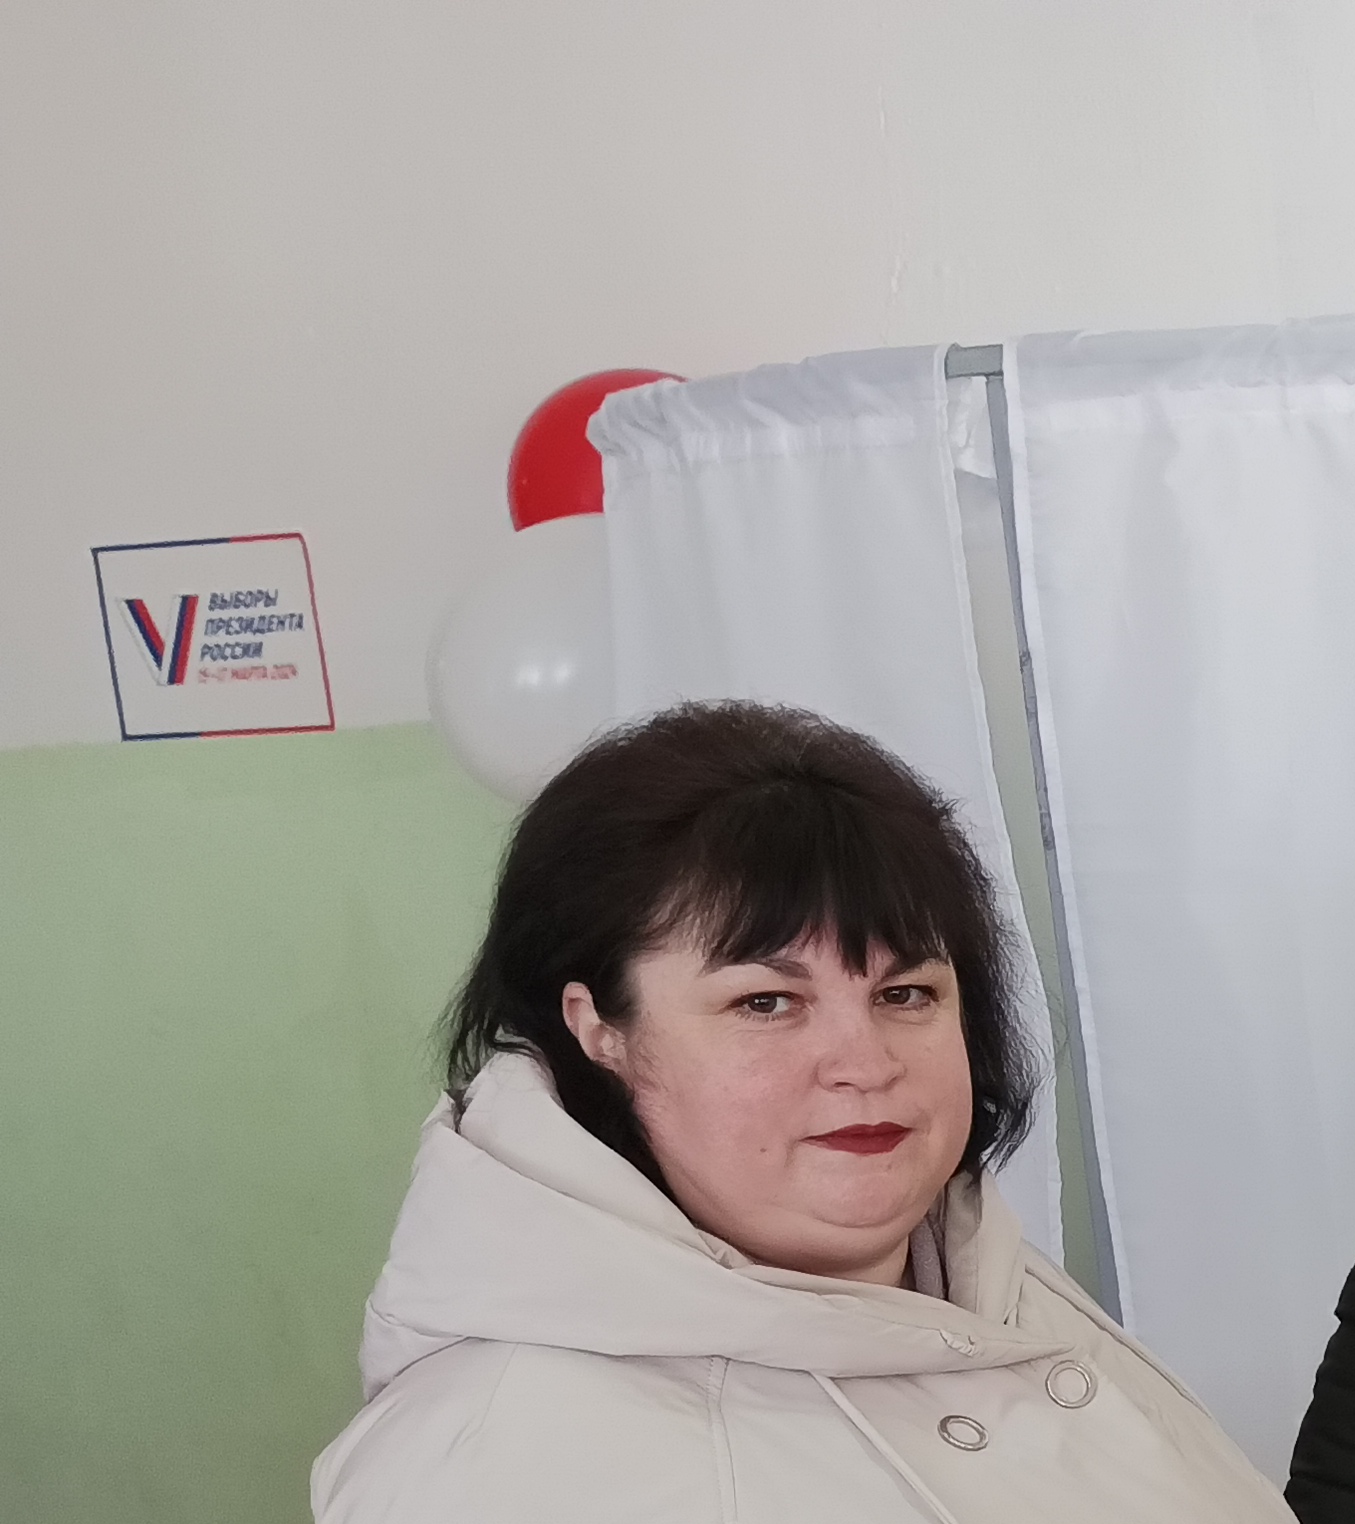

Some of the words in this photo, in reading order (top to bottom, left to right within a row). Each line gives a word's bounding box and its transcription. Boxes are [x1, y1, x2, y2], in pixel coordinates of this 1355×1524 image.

[208, 589, 278, 612] ВЫБОРЫ
[204, 613, 304, 636] ПРЕЗИДЕНТА
[200, 641, 263, 661] РОССИИ
